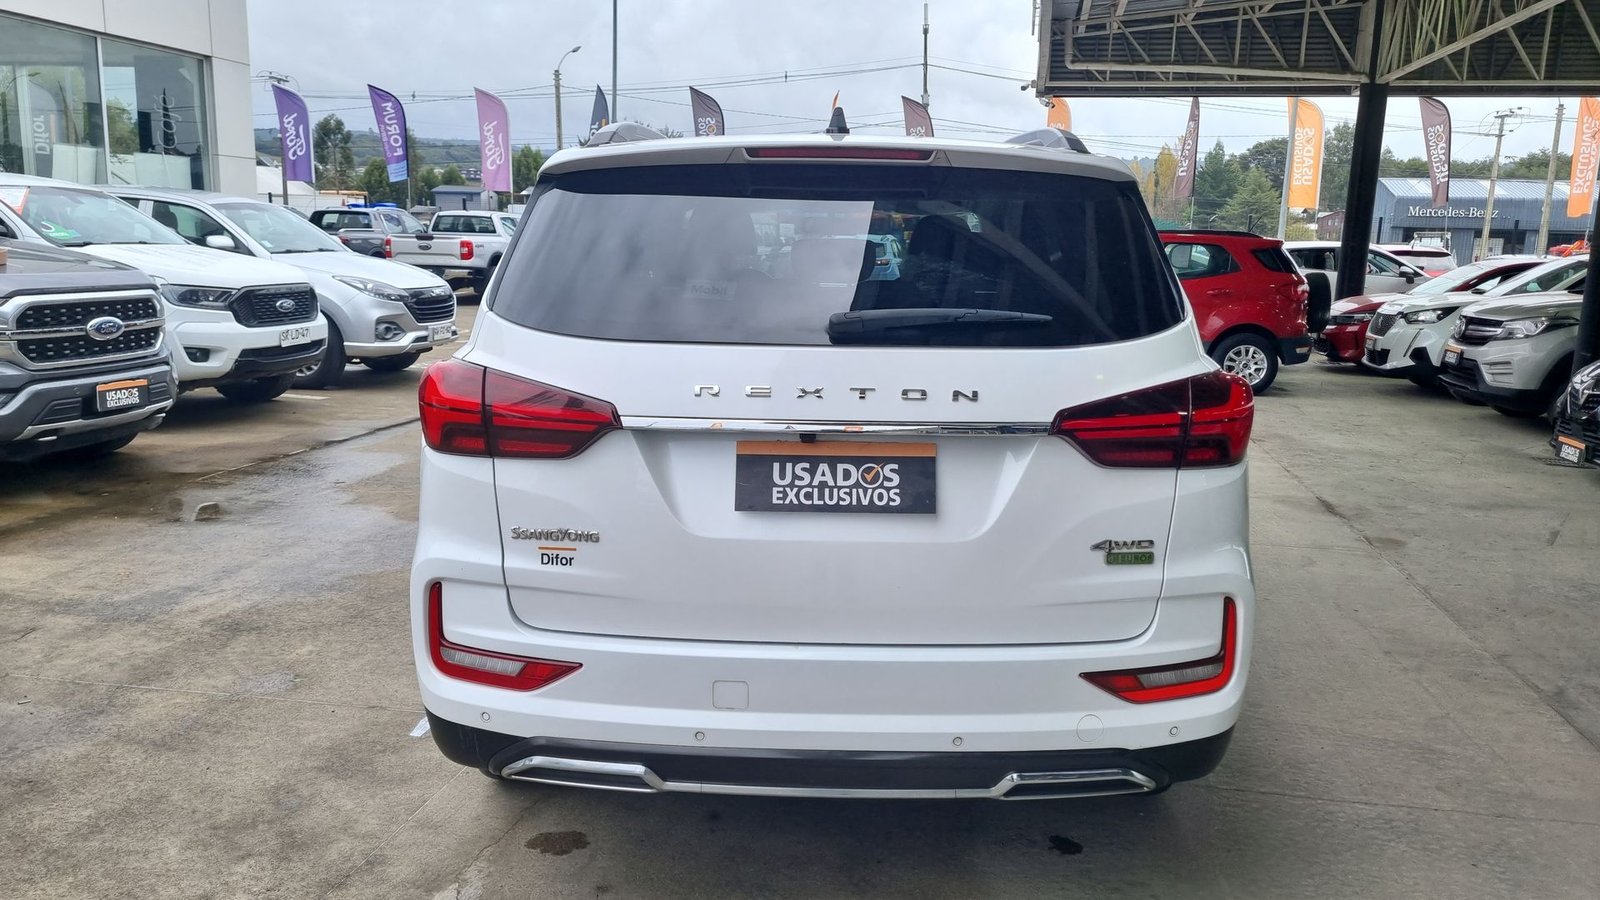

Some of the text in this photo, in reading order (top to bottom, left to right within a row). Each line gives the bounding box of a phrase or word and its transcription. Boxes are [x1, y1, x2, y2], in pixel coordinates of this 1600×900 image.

[1407, 206, 1499, 218] Mercedes-Bez
[106, 388, 139, 400] USADOS
[694, 384, 979, 402] REXTON
[107, 397, 140, 408] EXCLUSIVOS
[772, 462, 900, 488] USADOS
[772, 487, 901, 506] EXCLUSIVOS
[1090, 539, 1154, 553] 4WD
[540, 553, 575, 566] Difor
